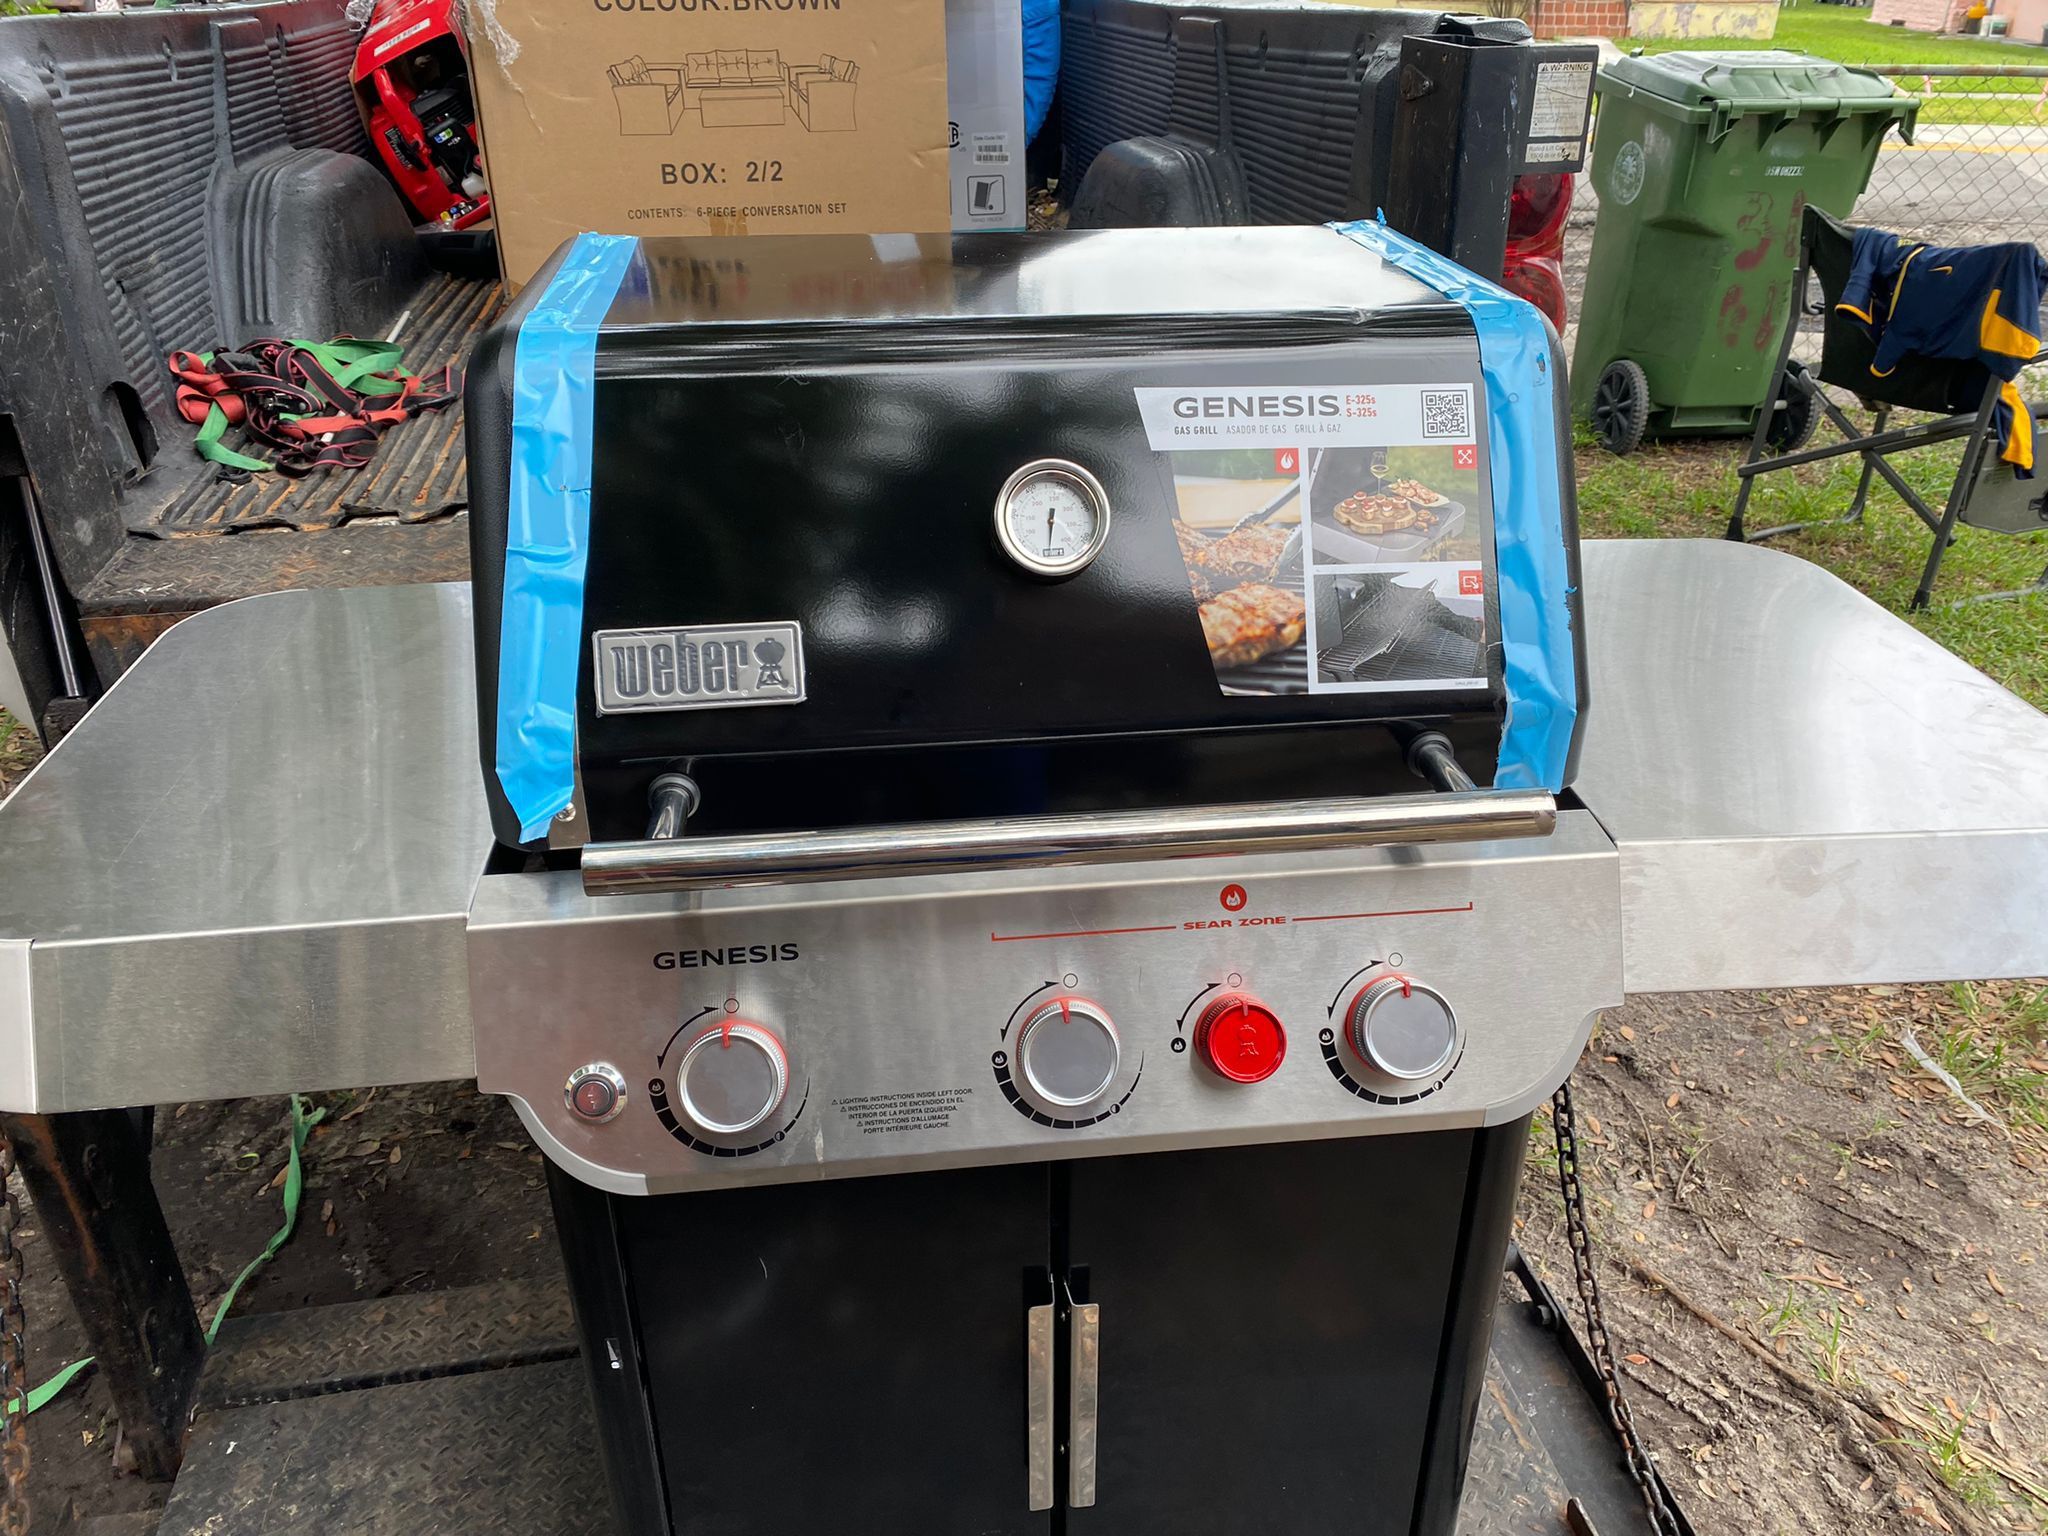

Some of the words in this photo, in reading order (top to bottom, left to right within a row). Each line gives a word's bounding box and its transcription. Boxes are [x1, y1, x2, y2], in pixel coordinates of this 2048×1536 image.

[661, 162, 727, 185] BOX:
[746, 160, 784, 183] 2/2
[696, 206, 737, 218] 6-PIECE
[742, 203, 823, 217] CONVERSATION
[827, 202, 848, 214] SET
[1173, 395, 1341, 419] GENESIS
[1345, 394, 1377, 405] E-325s
[1346, 407, 1378, 418] S-325s
[1174, 425, 1191, 435] GAS
[1193, 425, 1218, 435] GRILL
[1226, 424, 1257, 435] ASADOR
[1259, 424, 1269, 434] DE
[1271, 424, 1287, 434] GAS
[1294, 424, 1316, 433] GRILL
[1327, 423, 1342, 433] GAZ
[610, 633, 748, 699] weber
[1183, 919, 1234, 931] SEAR
[1238, 916, 1287, 928] ZONE
[653, 943, 800, 970] GENESIS
[839, 1096, 869, 1105] LIGHTING
[870, 1092, 915, 1102] INSTRUCTIONS
[916, 1090, 937, 1099] INSIDE
[938, 1089, 953, 1097] LEFT
[848, 1101, 898, 1112] INSTRUCCIONES
[899, 1100, 908, 1108] DE
[909, 1097, 945, 1107] ENCENDIDO
[946, 1096, 956, 1104] EN
[848, 1111, 878, 1120] INTERIOR
[878, 1110, 888, 1118] DE
[888, 1109, 898, 1117] LA
[898, 1107, 923, 1116] PUERTA
[864, 1117, 910, 1126] INSTRUCTIONS
